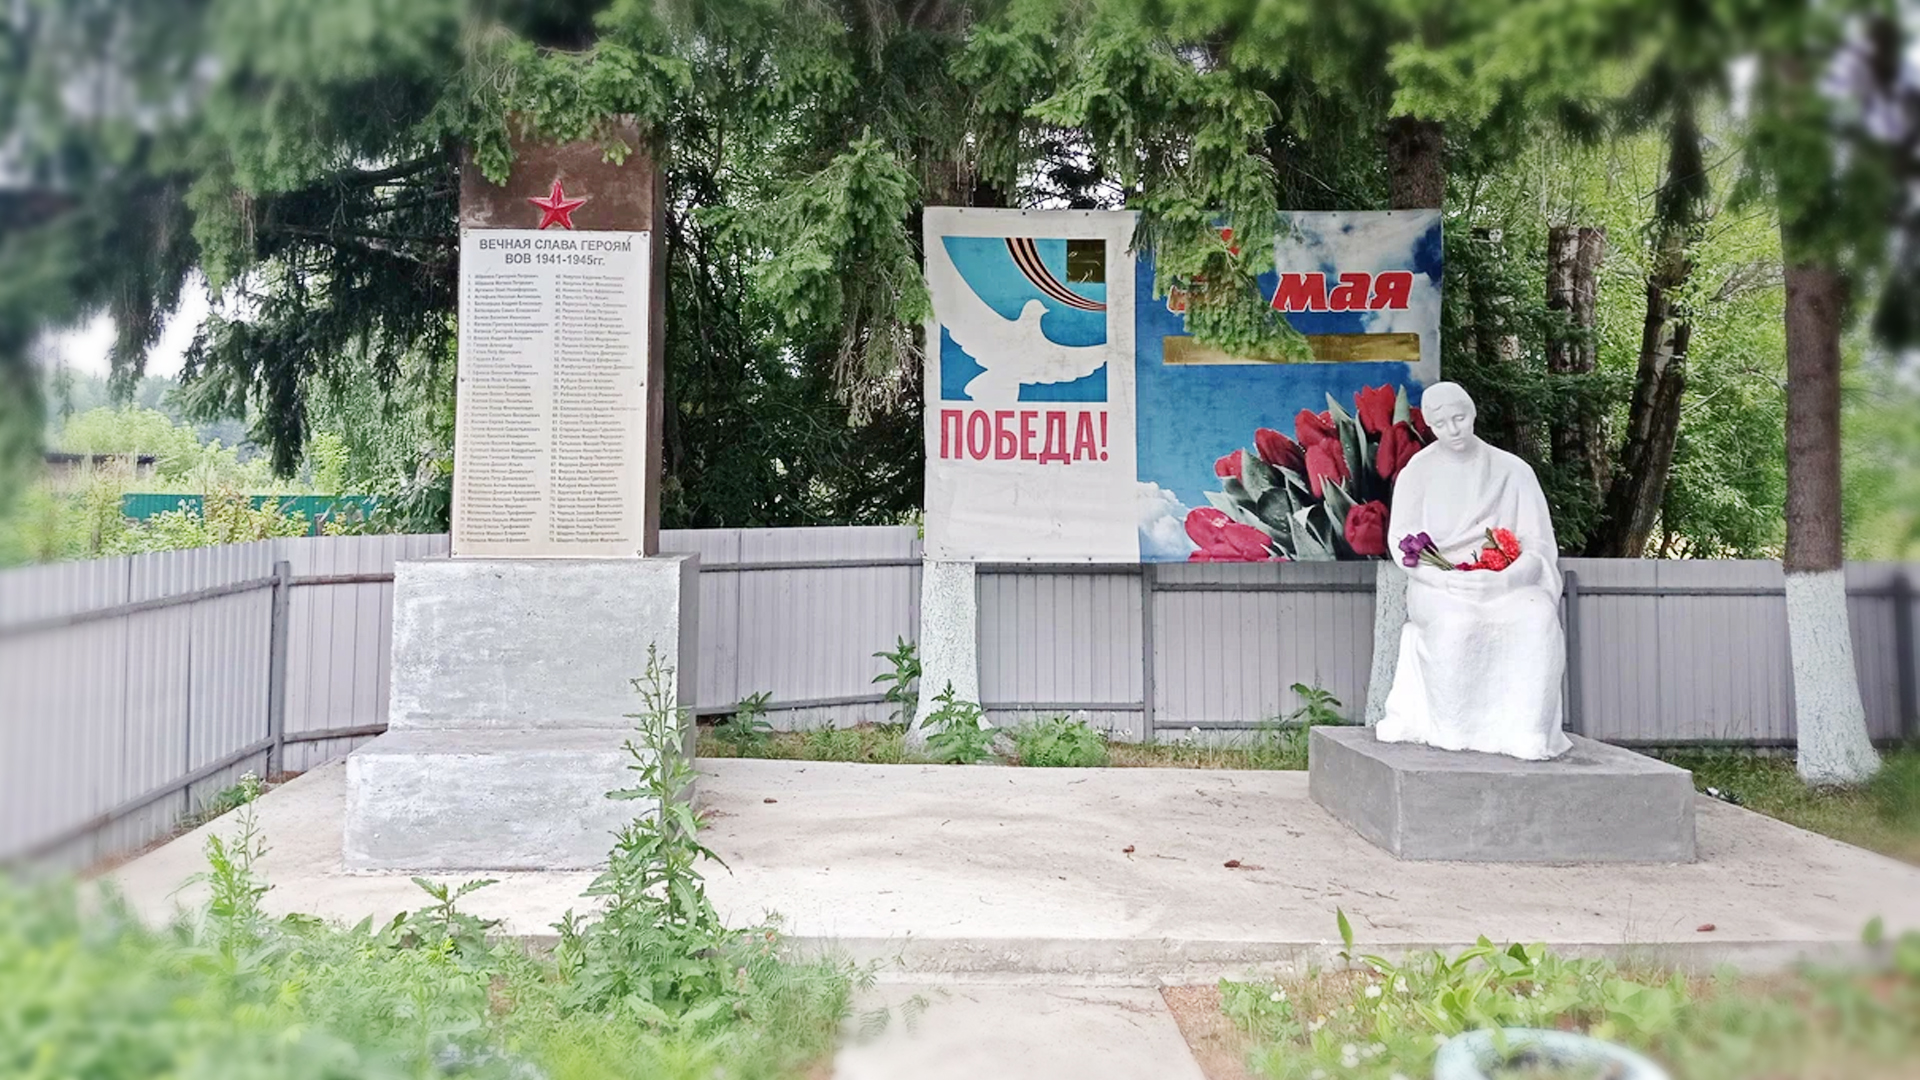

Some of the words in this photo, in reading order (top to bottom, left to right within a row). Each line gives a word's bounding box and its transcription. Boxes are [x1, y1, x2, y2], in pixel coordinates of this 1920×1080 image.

[479, 238, 531, 250] ВЕЧНАЯ
[534, 239, 577, 250] СЛАВА
[581, 240, 631, 251] ГЕРОЯМ
[505, 253, 532, 264] ВОВ
[536, 253, 606, 266] 1941-1945гг.
[1271, 271, 1413, 312] мая
[940, 409, 1109, 465] ПОБЕДА!
